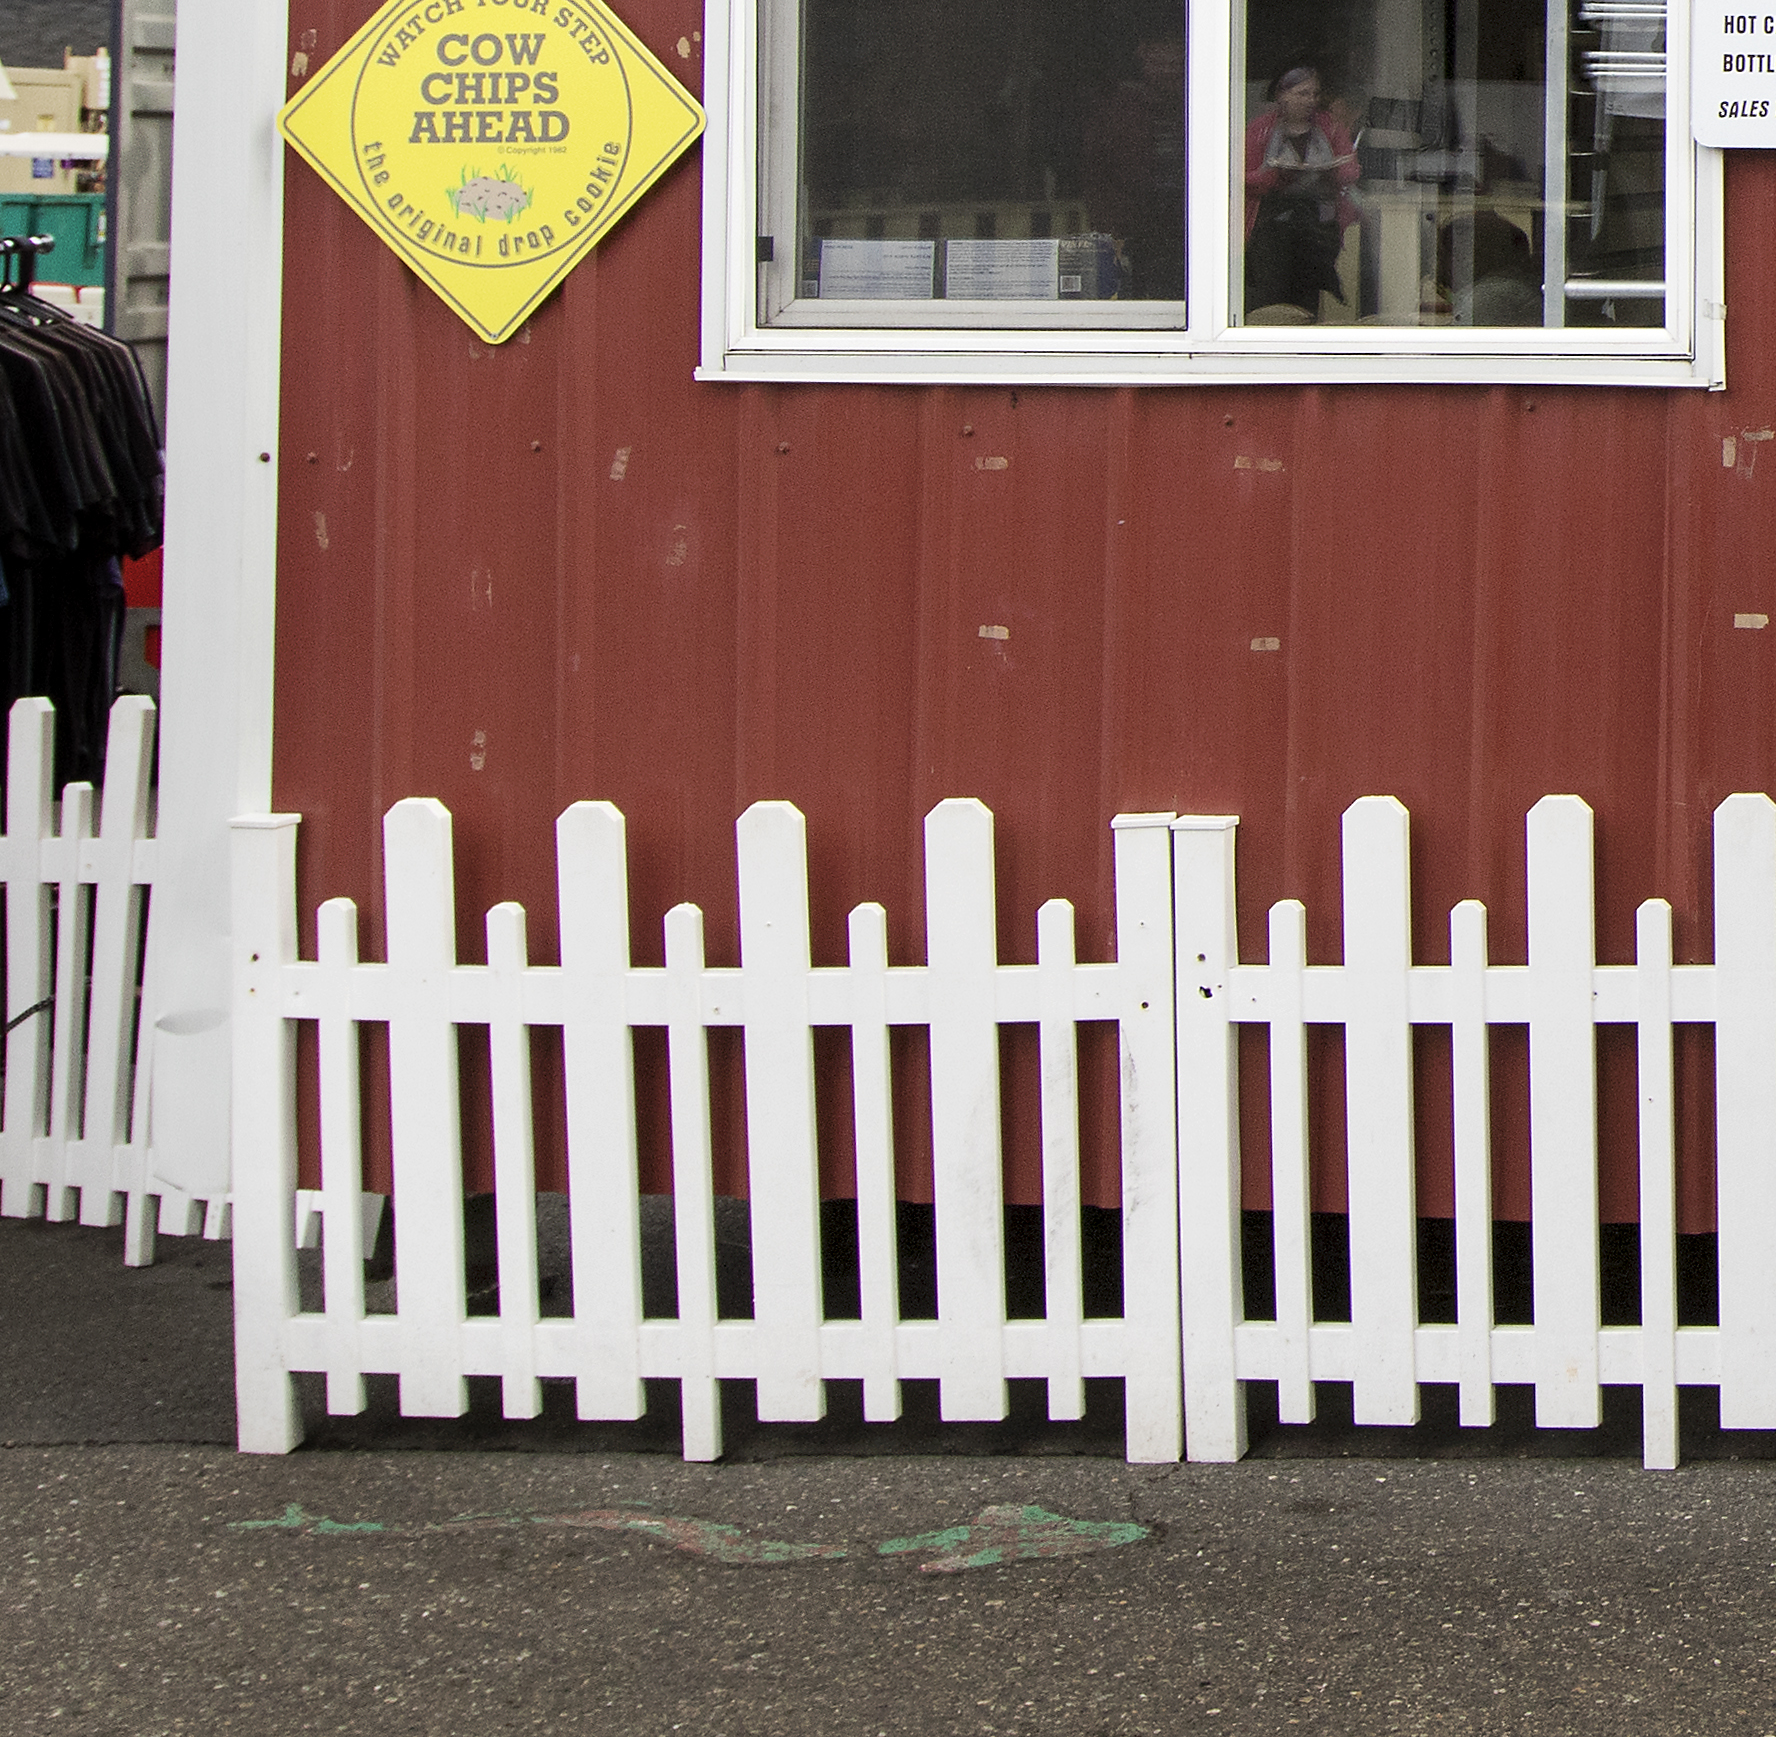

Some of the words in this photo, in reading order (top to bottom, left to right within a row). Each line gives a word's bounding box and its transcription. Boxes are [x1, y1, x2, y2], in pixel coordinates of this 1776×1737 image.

[553, 7, 610, 66] STEP
[1725, 16, 1756, 33] HOT
[436, 33, 546, 66] COW
[421, 72, 559, 105] CHIPS
[1719, 101, 1769, 117] SALES
[409, 111, 570, 143] AHEAD
[506, 146, 546, 155] Copyright
[548, 146, 566, 154] 1982
[364, 141, 390, 186] the
[387, 193, 482, 256] original
[499, 224, 555, 256] drop
[564, 141, 622, 227] cookie
